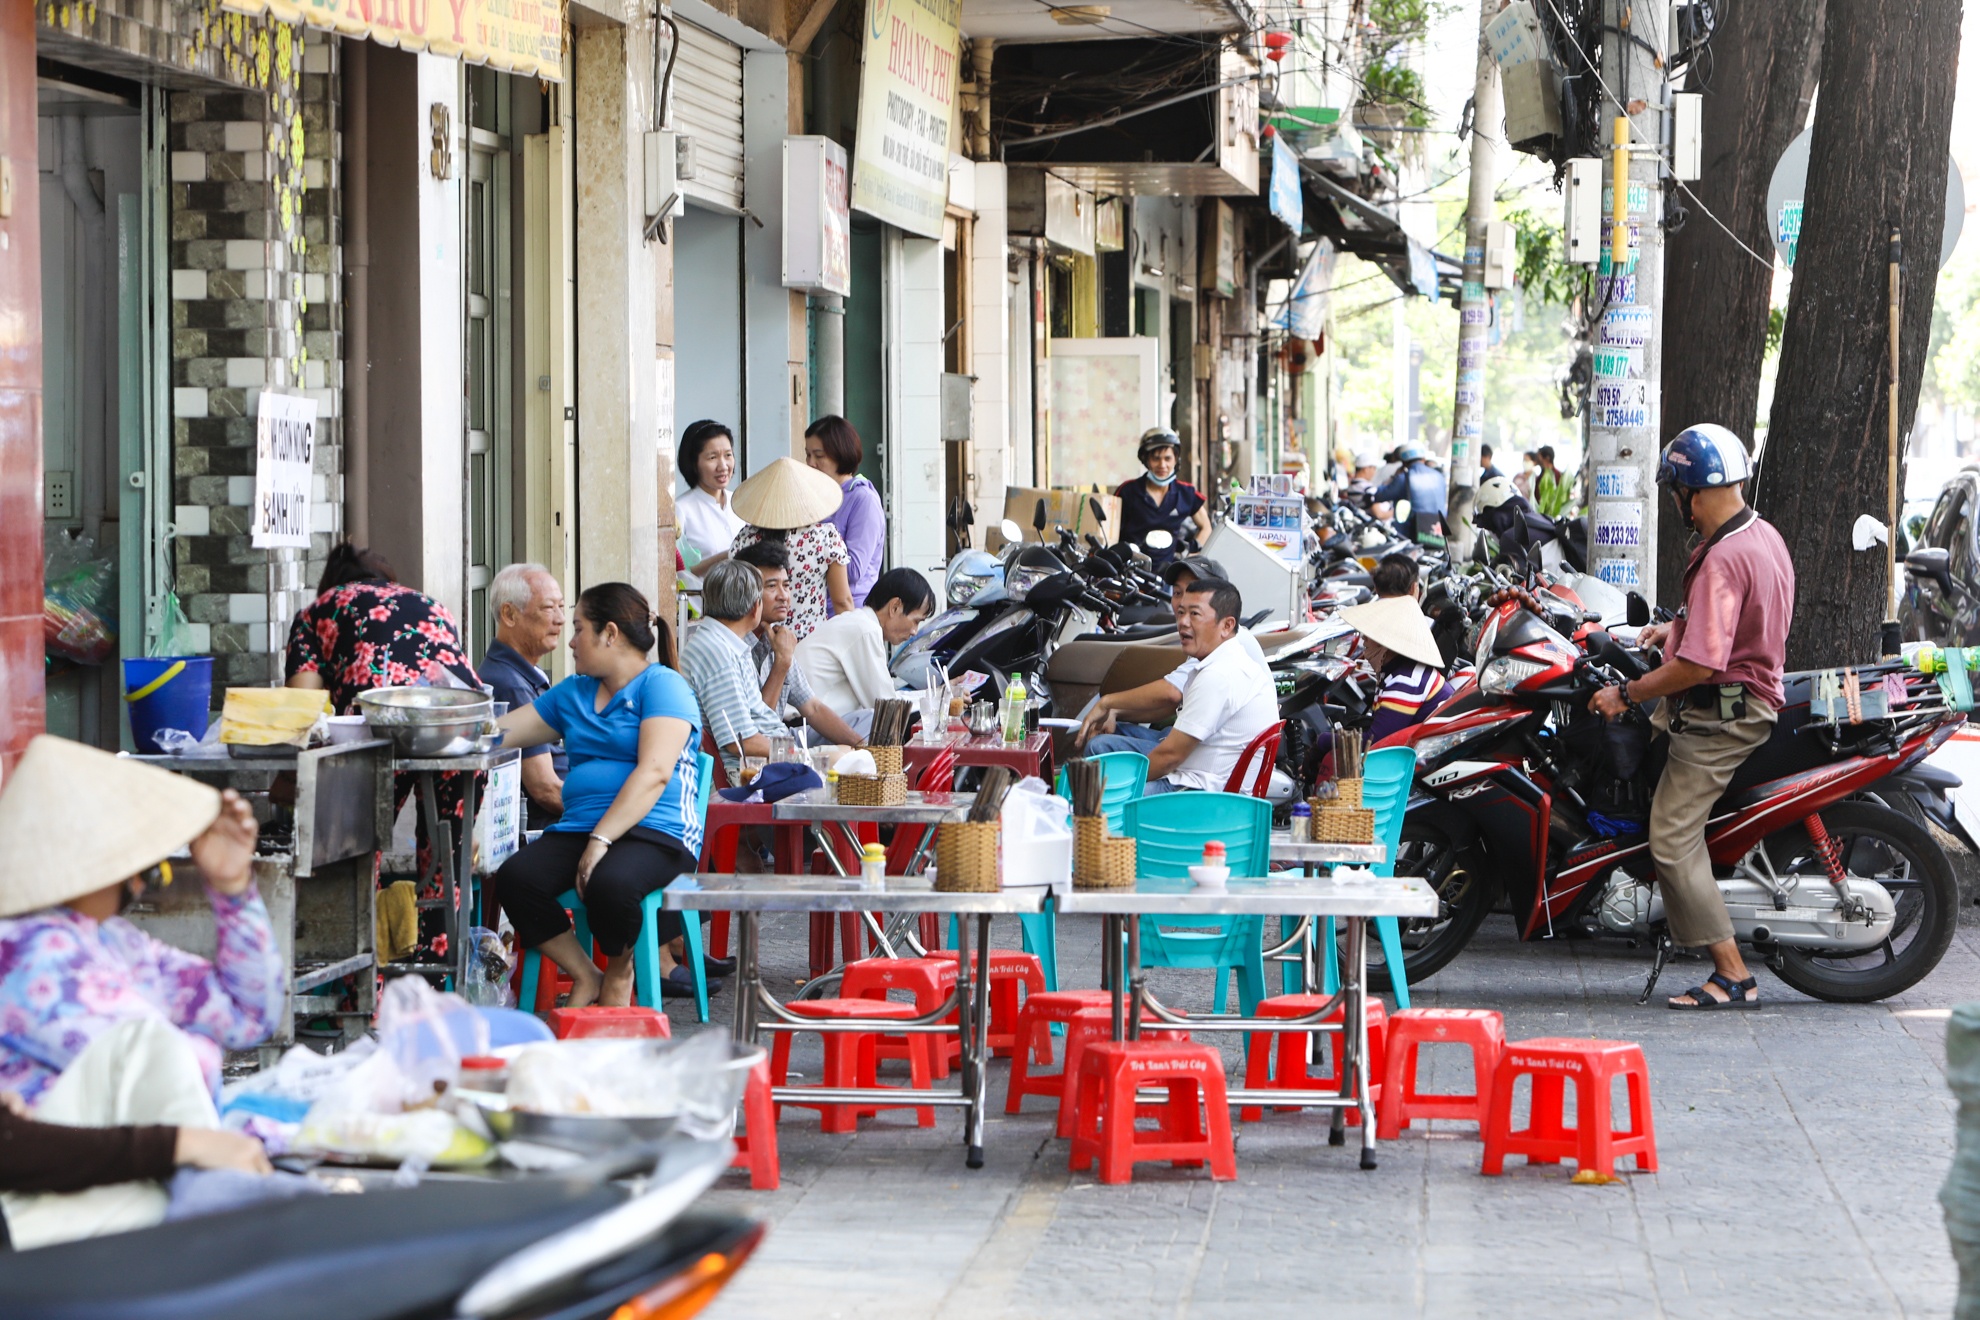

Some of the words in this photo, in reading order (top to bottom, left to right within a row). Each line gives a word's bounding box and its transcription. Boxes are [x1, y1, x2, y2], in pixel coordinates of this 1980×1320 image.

[887, 9, 931, 92] HOÀNG
[1606, 409, 1644, 427] 37584449
[1258, 532, 1287, 541] JAPAN
[1610, 525, 1624, 545] 233
[1625, 526, 1639, 545] 292
[1431, 771, 1459, 786] 110
[1567, 843, 1617, 866] HONDA
